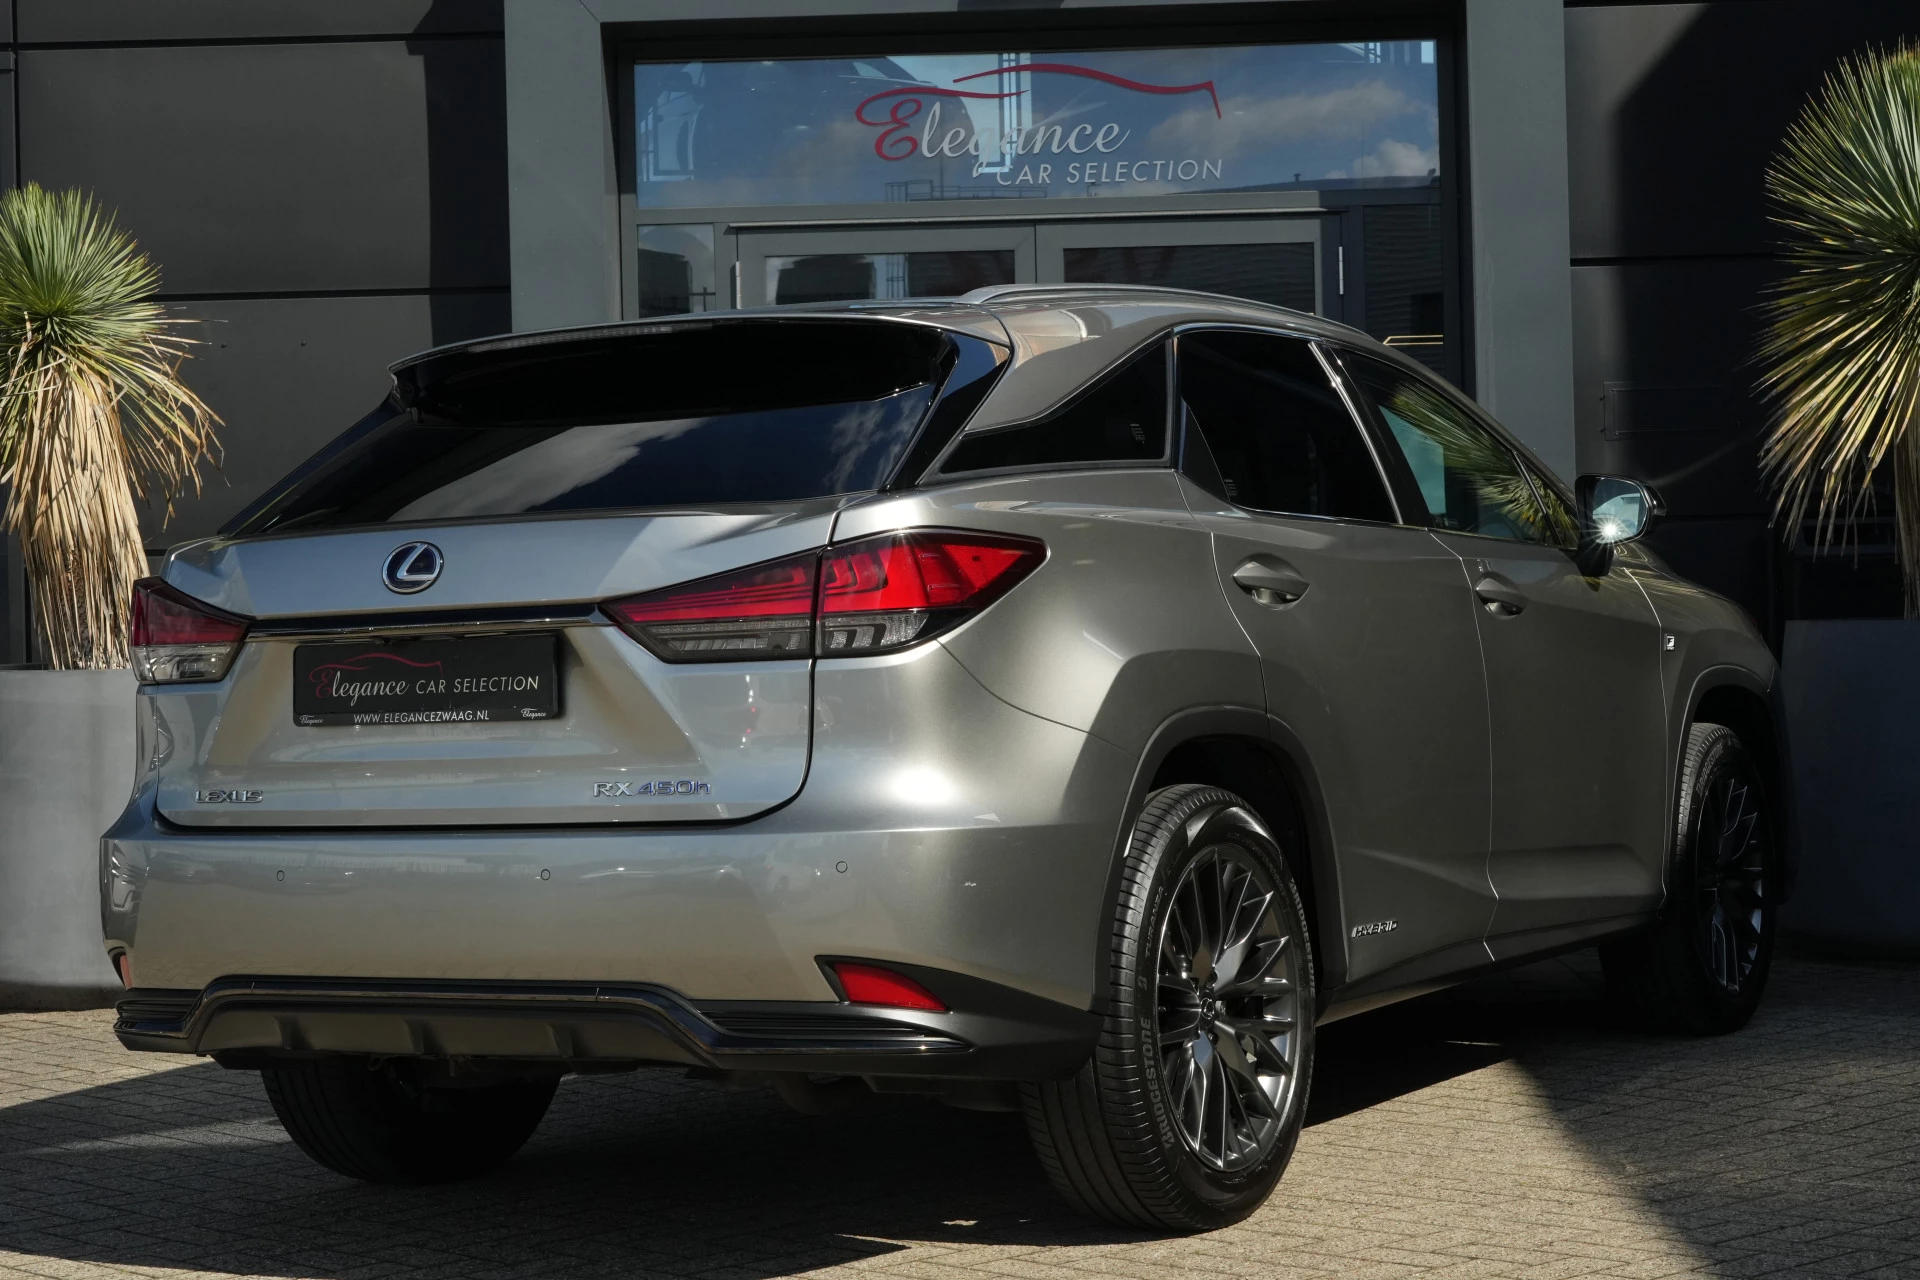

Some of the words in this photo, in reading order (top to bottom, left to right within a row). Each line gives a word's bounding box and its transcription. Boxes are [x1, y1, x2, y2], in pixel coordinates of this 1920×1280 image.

[856, 88, 1131, 178] Elegance
[996, 164, 1052, 186] CAR
[1066, 159, 1223, 184] SELECTION
[309, 664, 410, 707] Elegance
[416, 679, 446, 694] CAR
[453, 675, 539, 693] SELECTION
[300, 715, 324, 726] Elegance
[353, 709, 490, 724] WWW.ELEGANCEZWAAG.NL
[521, 708, 547, 719] Elegance
[195, 789, 263, 804] LEXUS
[593, 781, 632, 797] RX
[637, 780, 711, 796] 450h
[1350, 920, 1398, 938] HYBRID
[1141, 1017, 1175, 1149] BRIDGESTONE
